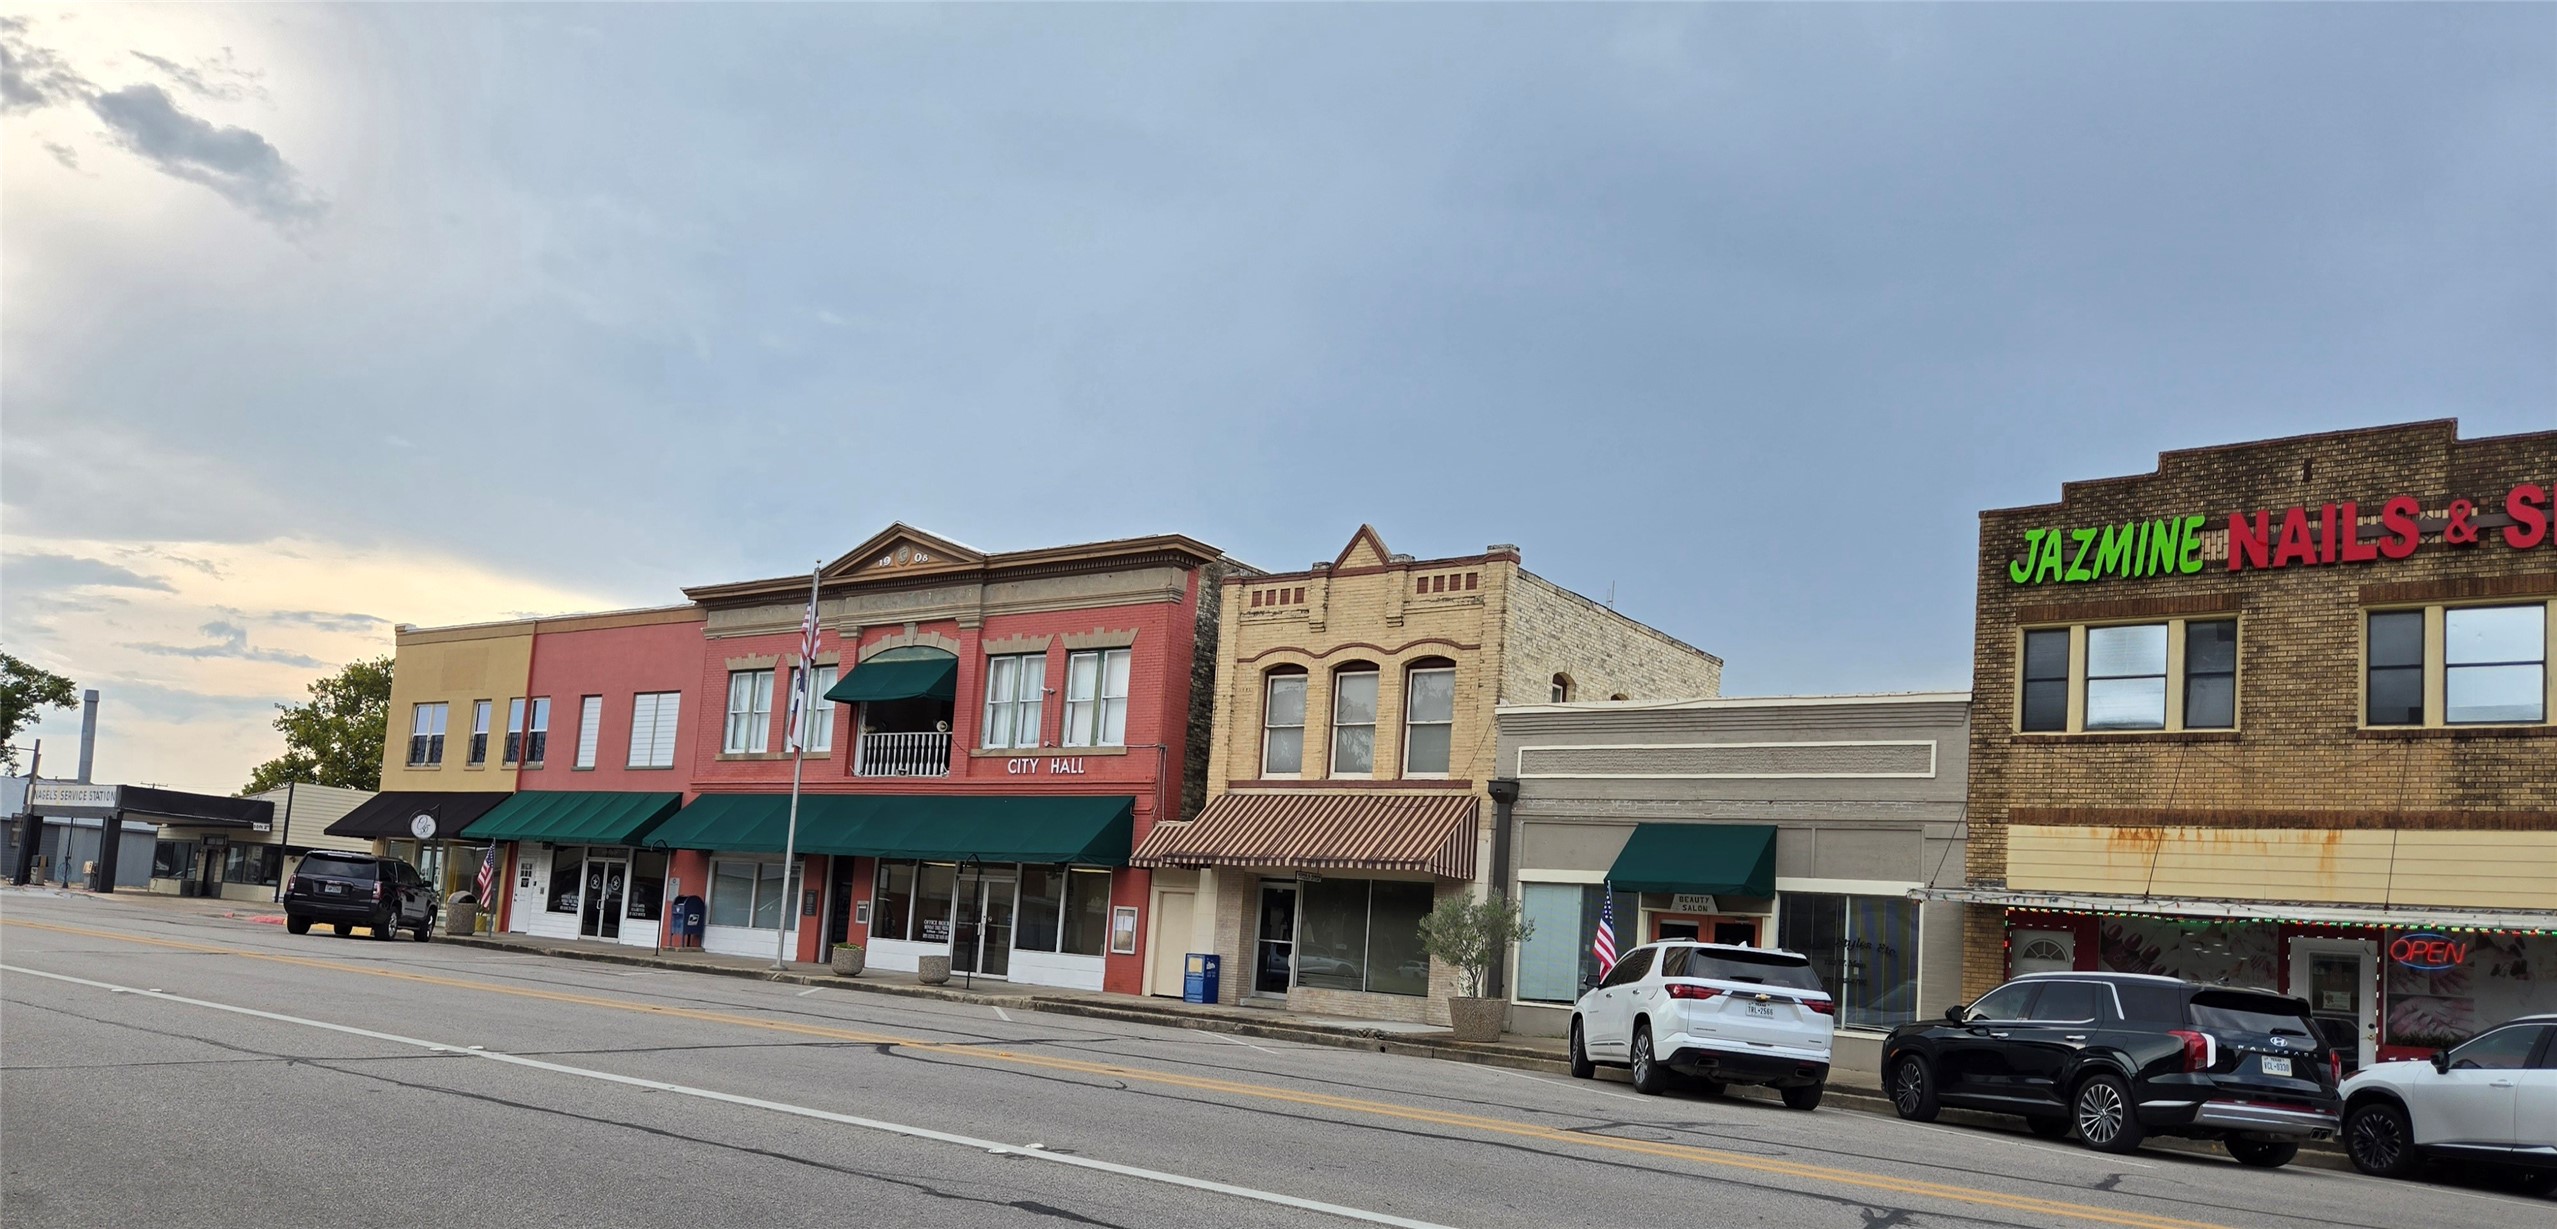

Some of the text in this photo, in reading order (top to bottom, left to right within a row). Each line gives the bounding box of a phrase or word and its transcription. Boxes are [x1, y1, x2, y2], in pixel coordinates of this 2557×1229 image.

[2010, 483, 2557, 584] JAZMINE NAILS & S
[1007, 757, 1085, 774] CITY HALL
[60, 790, 87, 801] SERVICE
[89, 790, 116, 802] STATION
[1678, 895, 1710, 904] BEAUTY
[1682, 904, 1708, 912] SALON
[2389, 939, 2467, 964] OPEN
